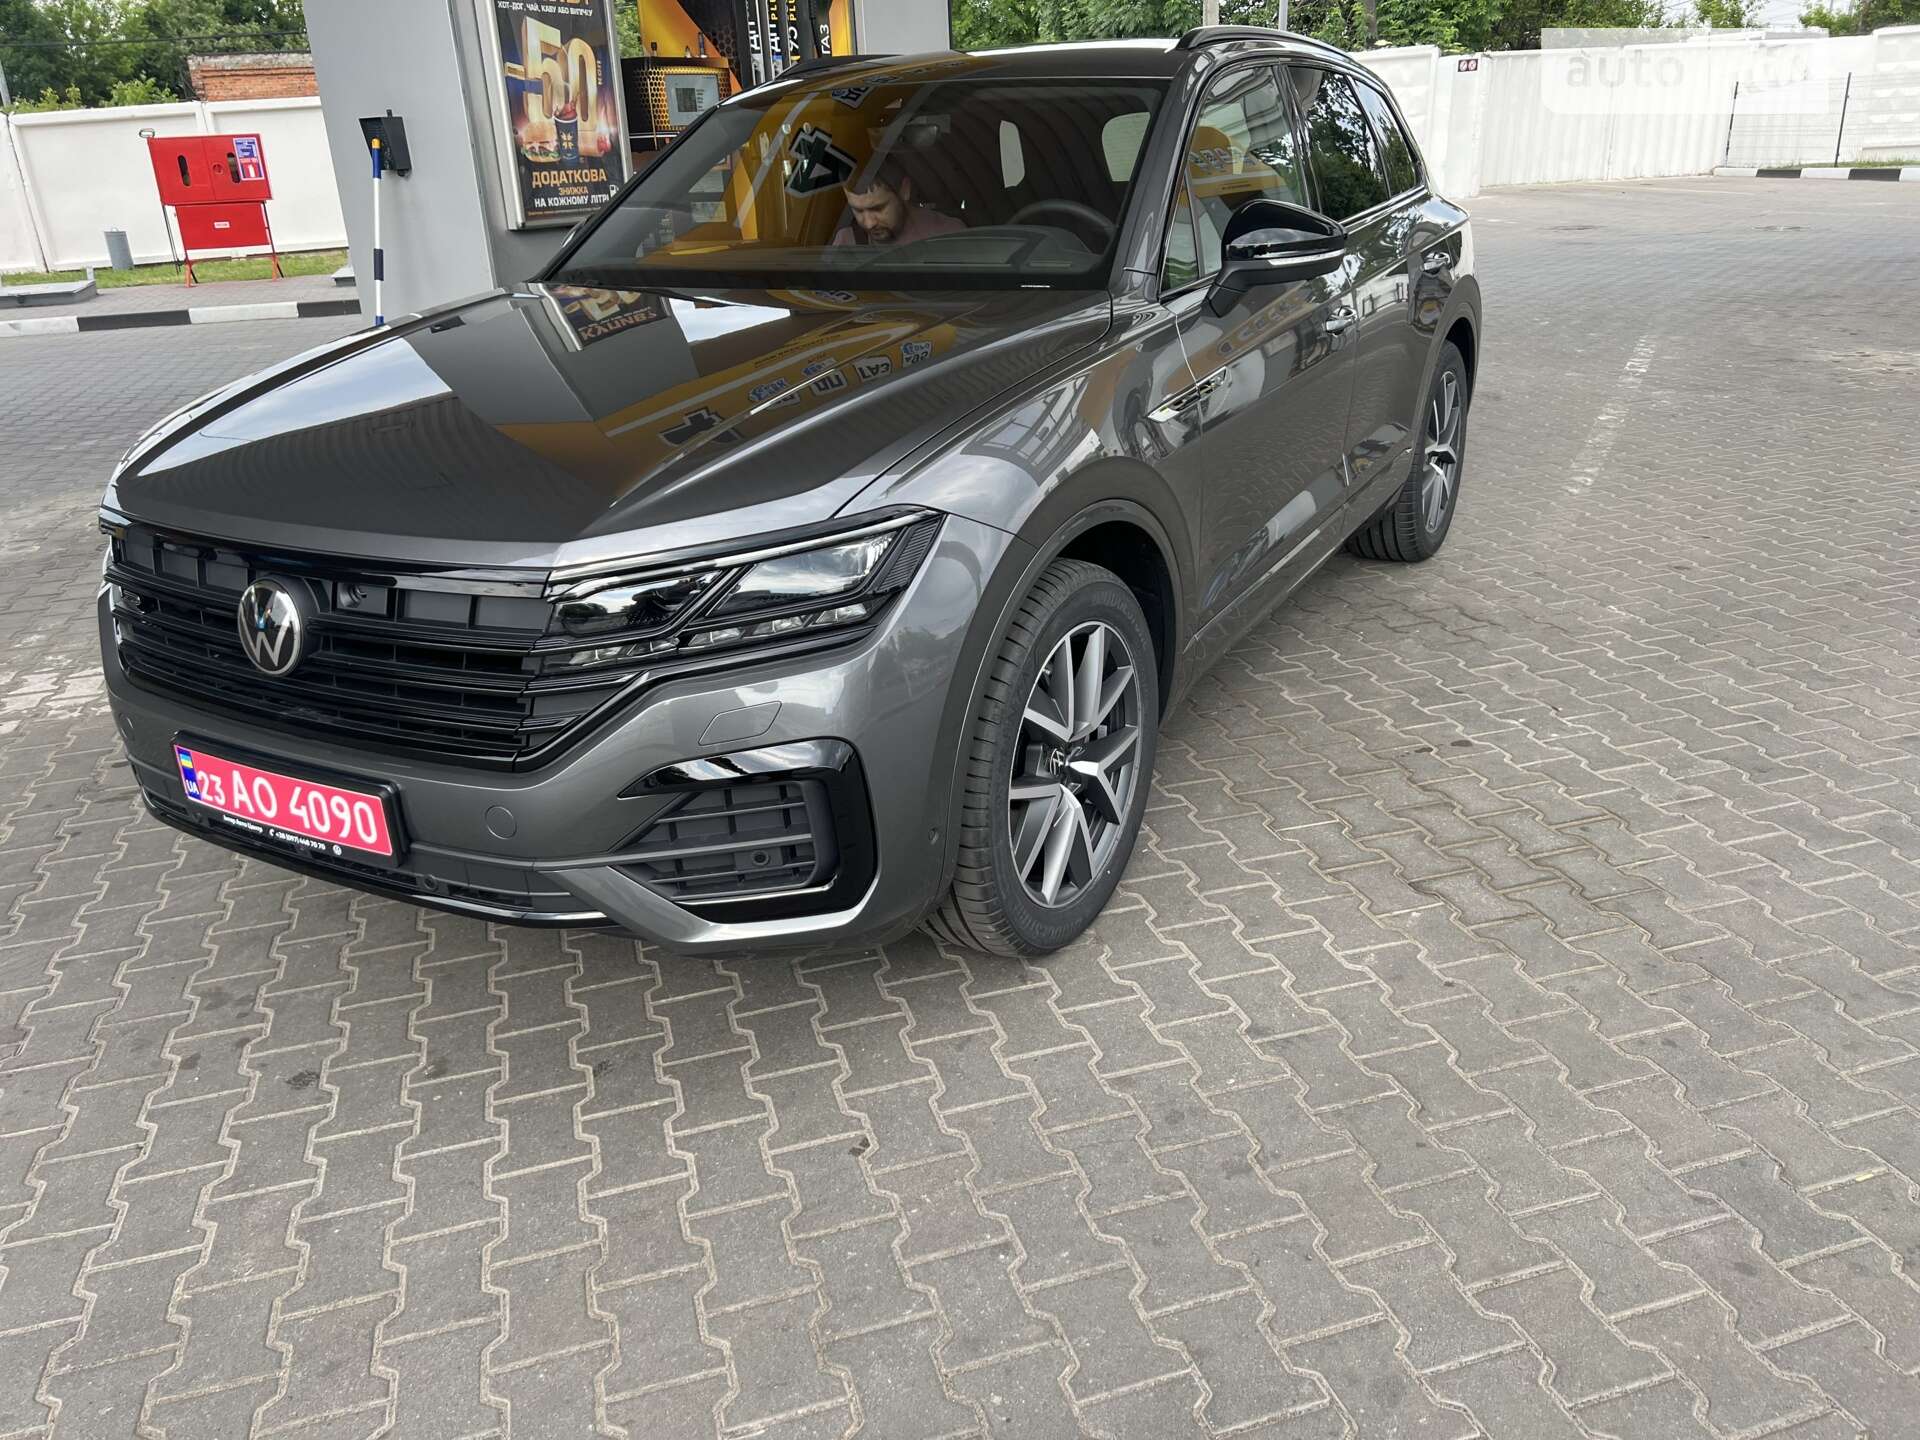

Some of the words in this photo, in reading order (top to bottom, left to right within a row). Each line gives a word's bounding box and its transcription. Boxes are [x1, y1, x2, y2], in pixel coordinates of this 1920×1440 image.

[820, 24, 831, 54] ГАЗ
[532, 168, 607, 188] ДОДАТКОВА
[558, 186, 589, 196] ЗНИЖКА
[534, 198, 547, 208] НА
[547, 195, 589, 207] КОЖНОМУ
[186, 779, 200, 795] UA
[198, 770, 225, 805] 23
[289, 786, 378, 844] 4090
